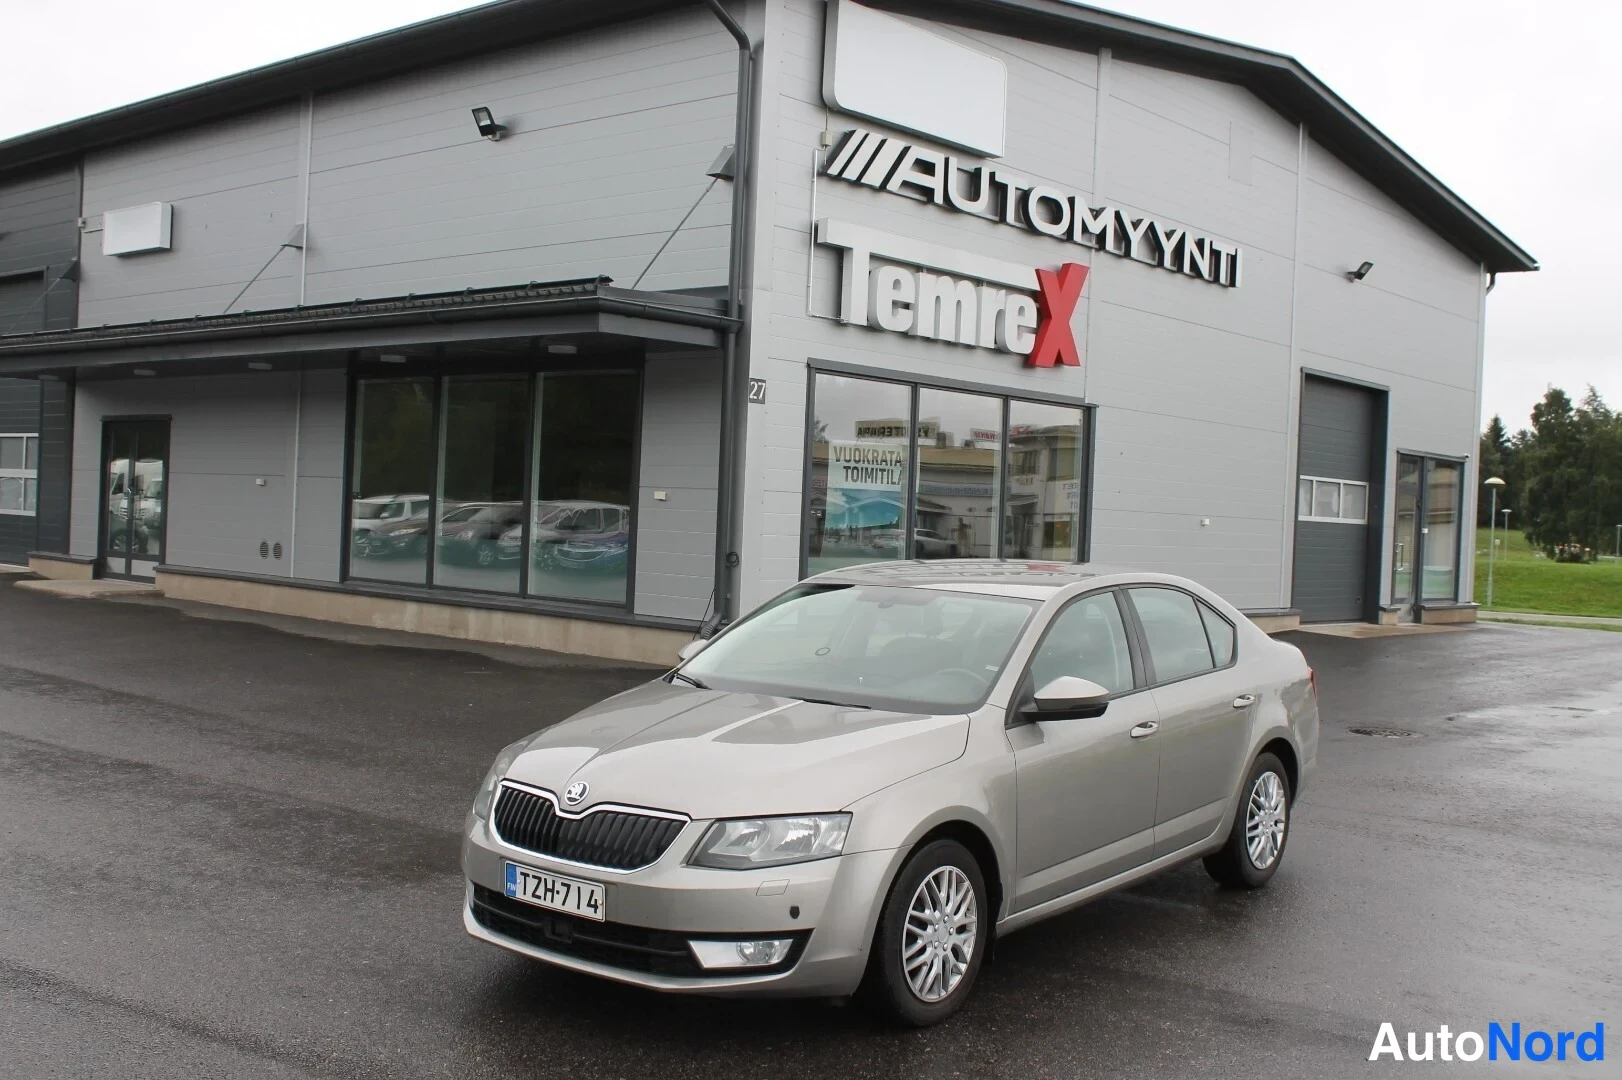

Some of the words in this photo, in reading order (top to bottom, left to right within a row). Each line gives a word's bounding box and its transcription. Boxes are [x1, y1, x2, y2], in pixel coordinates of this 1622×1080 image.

[885, 144, 1242, 288] AUTOMYYNTI
[817, 217, 1090, 368] TemreX
[749, 381, 766, 400] 27
[833, 445, 902, 468] VUOKRATA
[507, 882, 517, 892] FIN
[519, 871, 599, 914] TZH-714
